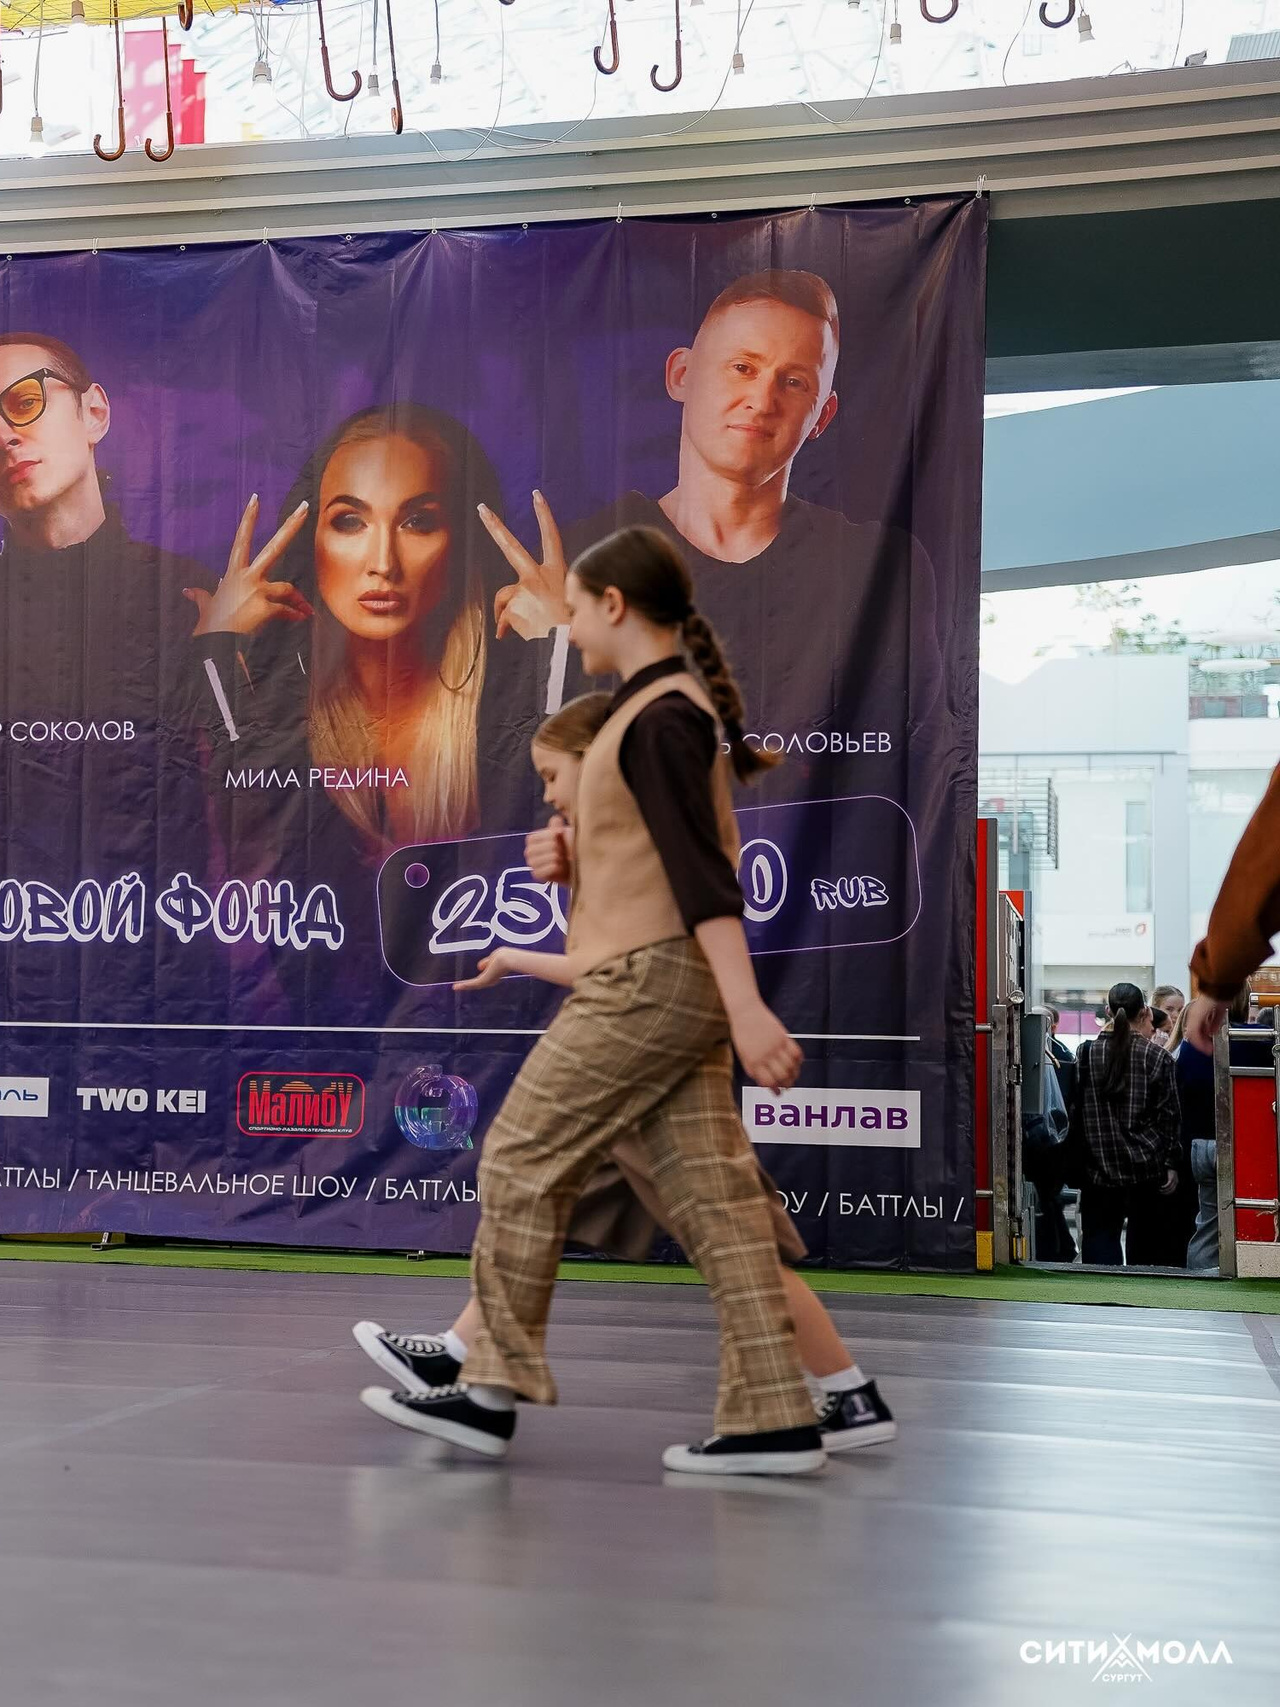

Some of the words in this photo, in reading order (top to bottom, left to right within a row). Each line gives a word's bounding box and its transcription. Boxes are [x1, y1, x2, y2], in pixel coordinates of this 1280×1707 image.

[9, 720, 136, 743] СОКОЛОВ
[742, 731, 892, 754] СОЛОВЬЕВ
[225, 769, 301, 789] МИЛА
[308, 768, 410, 790] РЕДИНА
[155, 872, 344, 951] ФОНД
[429, 866, 573, 954] 25
[810, 875, 889, 910] RUB
[76, 1086, 148, 1112] TWO
[156, 1088, 207, 1114] KEI
[753, 1103, 909, 1130] ванлав
[86, 1169, 284, 1196] ТАНЦЕВАЛЬНОЕ
[292, 1174, 358, 1198] ШОУ
[384, 1178, 481, 1202] БАТТЛЫ
[839, 1193, 944, 1219] БАТТЛЫ
